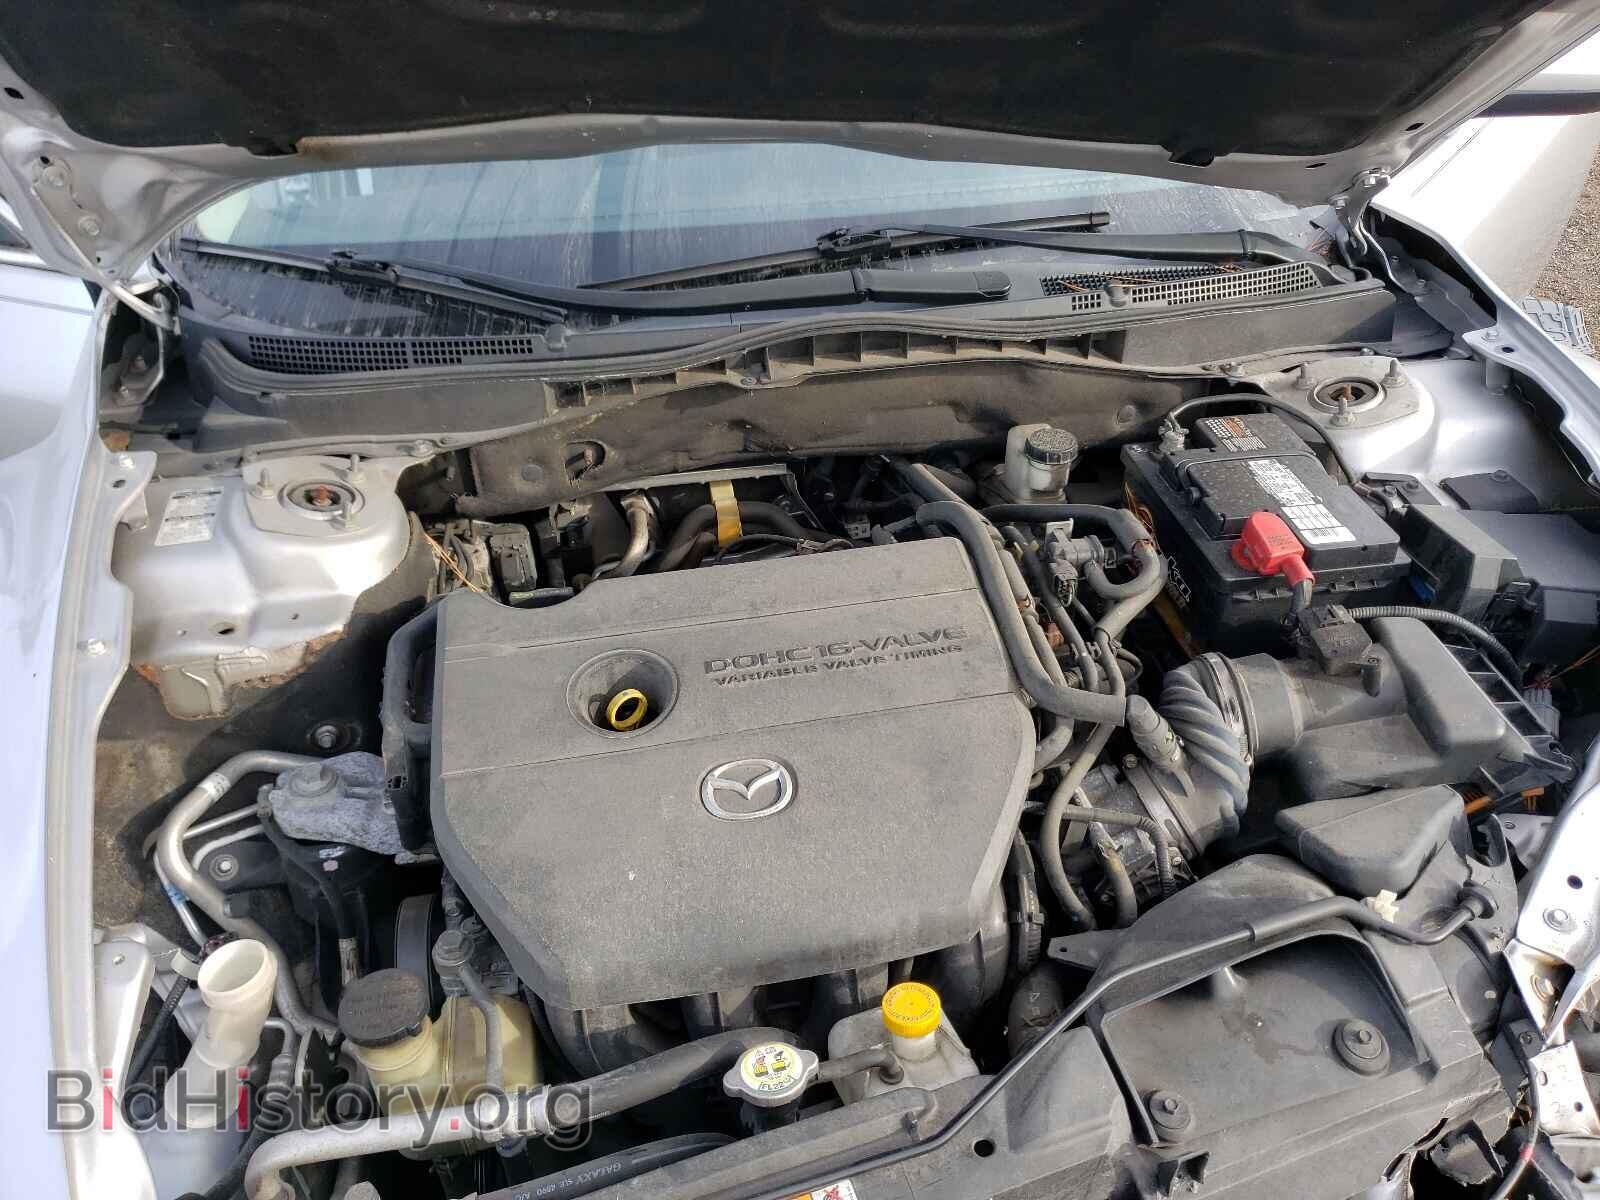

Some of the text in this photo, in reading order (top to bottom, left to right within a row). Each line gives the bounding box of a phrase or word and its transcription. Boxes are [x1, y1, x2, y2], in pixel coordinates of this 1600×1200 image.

[704, 626, 966, 674] DOHC 16-VALVE
[713, 645, 963, 687] VARIABLE VALVE TIMING
[576, 1161, 622, 1185] GALAXY
